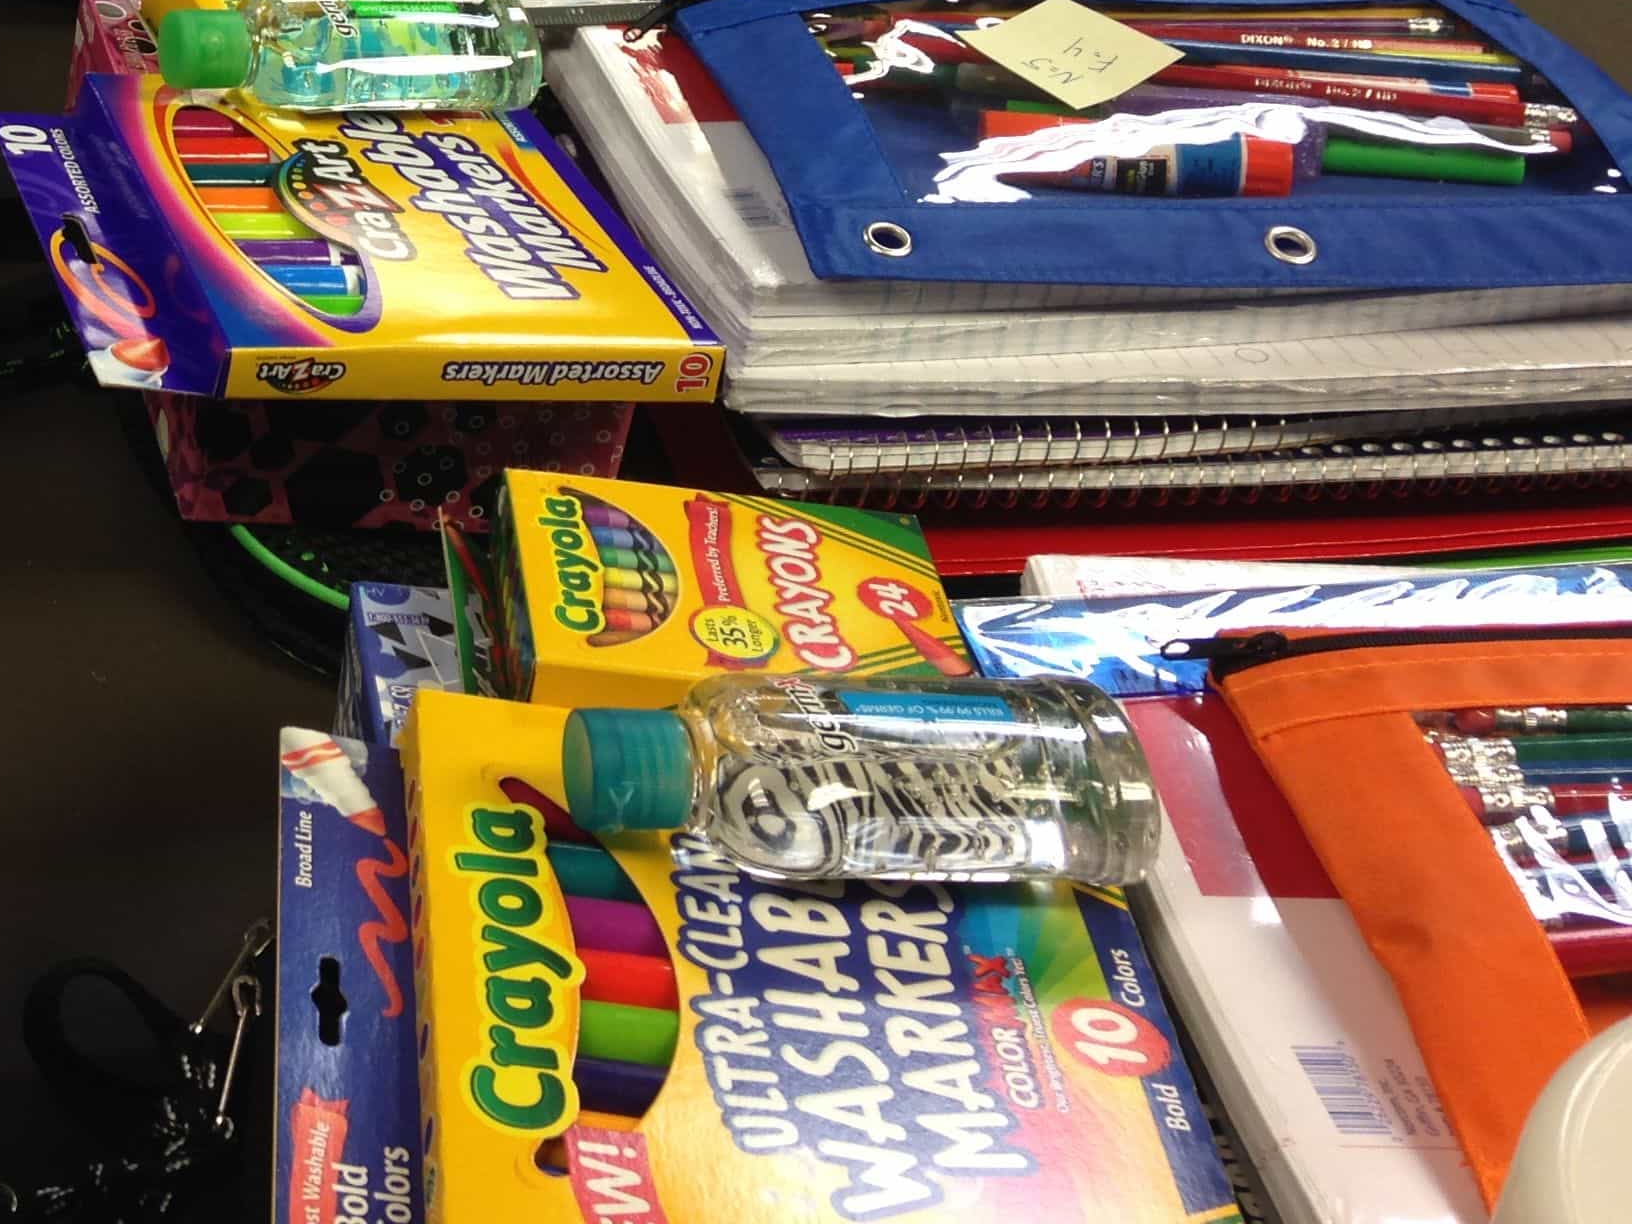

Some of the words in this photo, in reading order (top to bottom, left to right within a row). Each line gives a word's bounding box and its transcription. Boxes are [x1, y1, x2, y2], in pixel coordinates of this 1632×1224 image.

[1241, 32, 1286, 46] DIXON
[50, 127, 77, 161] COLORS
[63, 159, 101, 215] ASSORTED
[342, 112, 581, 300] Washable
[425, 133, 609, 273] Markers
[444, 361, 548, 385] Markers
[549, 361, 664, 385] Assorted
[675, 353, 713, 394] 10
[703, 506, 720, 547] Teachers!
[554, 494, 605, 633] Crayola
[711, 560, 731, 602] Preferred
[761, 516, 854, 670] CRAYONS
[867, 582, 918, 618] 24
[705, 618, 719, 643] Lasts
[721, 615, 749, 650] 35%
[745, 620, 765, 653] Longer
[295, 809, 312, 845] Line
[294, 844, 313, 889] Broad
[454, 805, 575, 1130] Crayola
[1110, 948, 1146, 1008] Colors
[1071, 1006, 1149, 1065] 10
[991, 1027, 1039, 1109] COLOR
[1151, 1082, 1192, 1132] Bold
[302, 1120, 331, 1206] Washable
[332, 1161, 368, 1224] Bold
